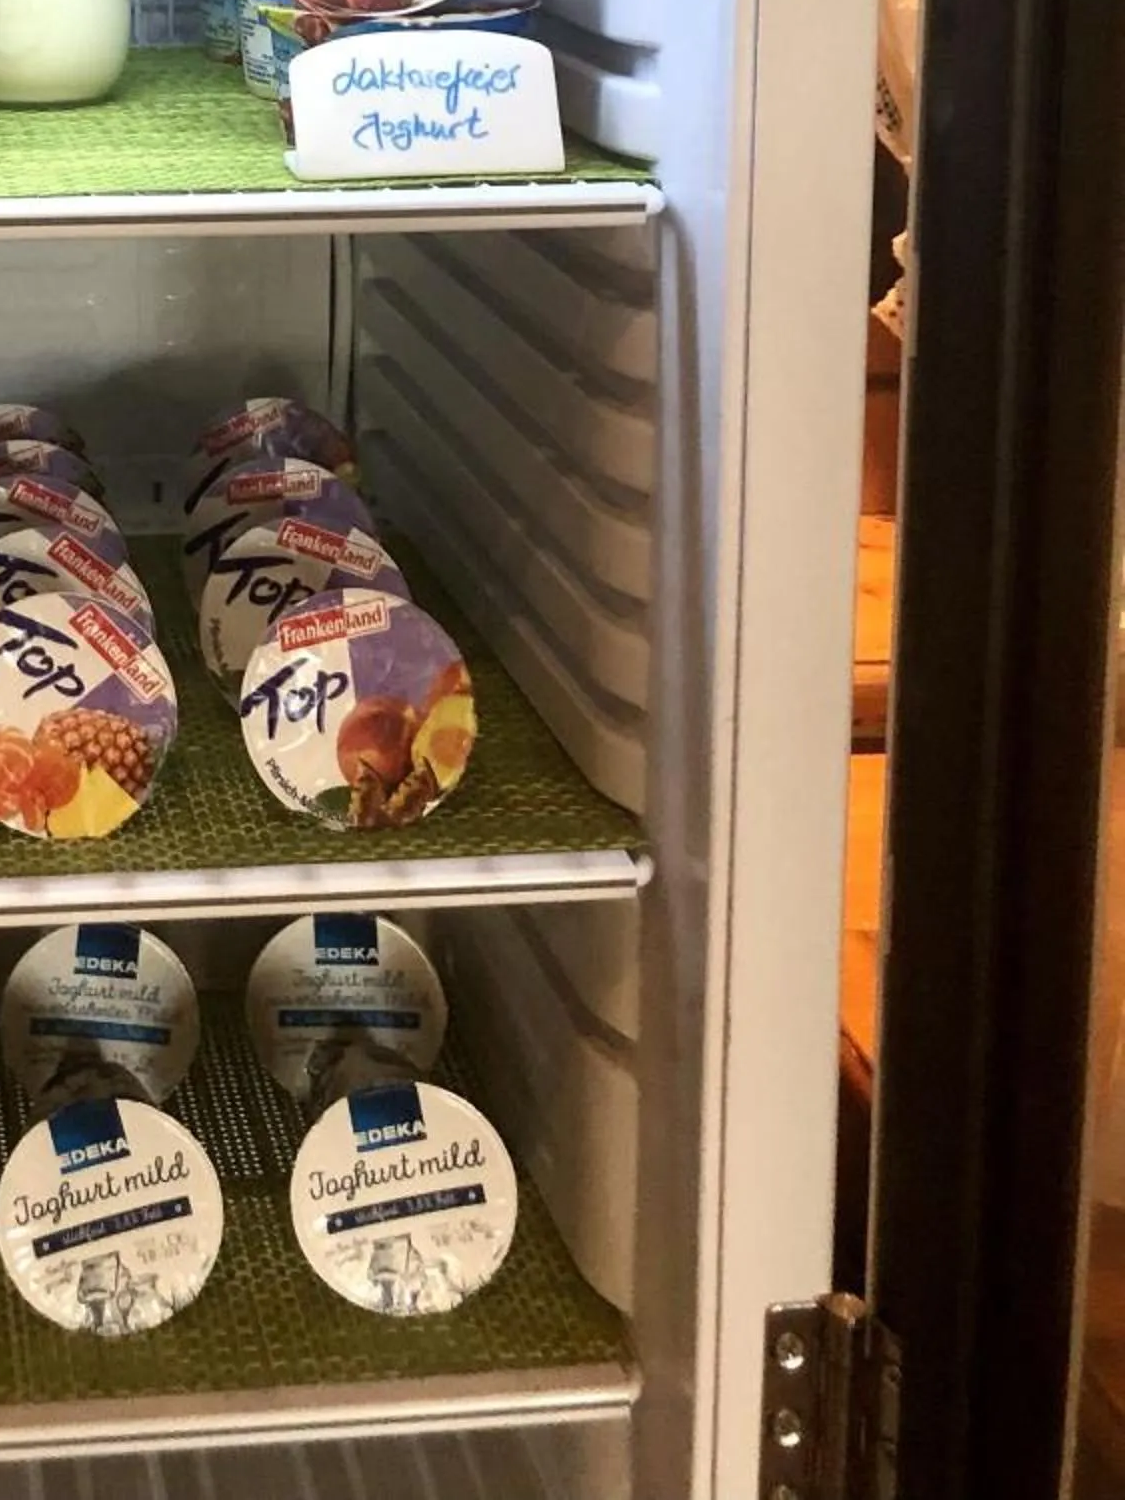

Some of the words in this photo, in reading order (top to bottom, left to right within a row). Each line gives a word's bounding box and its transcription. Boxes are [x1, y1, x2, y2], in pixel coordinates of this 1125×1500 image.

[283, 524, 377, 571] Frankenland
[55, 539, 137, 610] Frankenland
[281, 604, 383, 645] Frankenland
[76, 612, 161, 691] Frankenland
[240, 657, 348, 740] Top
[75, 956, 138, 972] EDEKA
[315, 947, 378, 960] EDEKA
[63, 1137, 127, 1167] EDEKA
[355, 1120, 425, 1145] EDEKA
[14, 1171, 121, 1226] Joghurt
[124, 1151, 190, 1192] mild
[309, 1153, 415, 1201] Joghurt
[420, 1139, 486, 1175] mild
